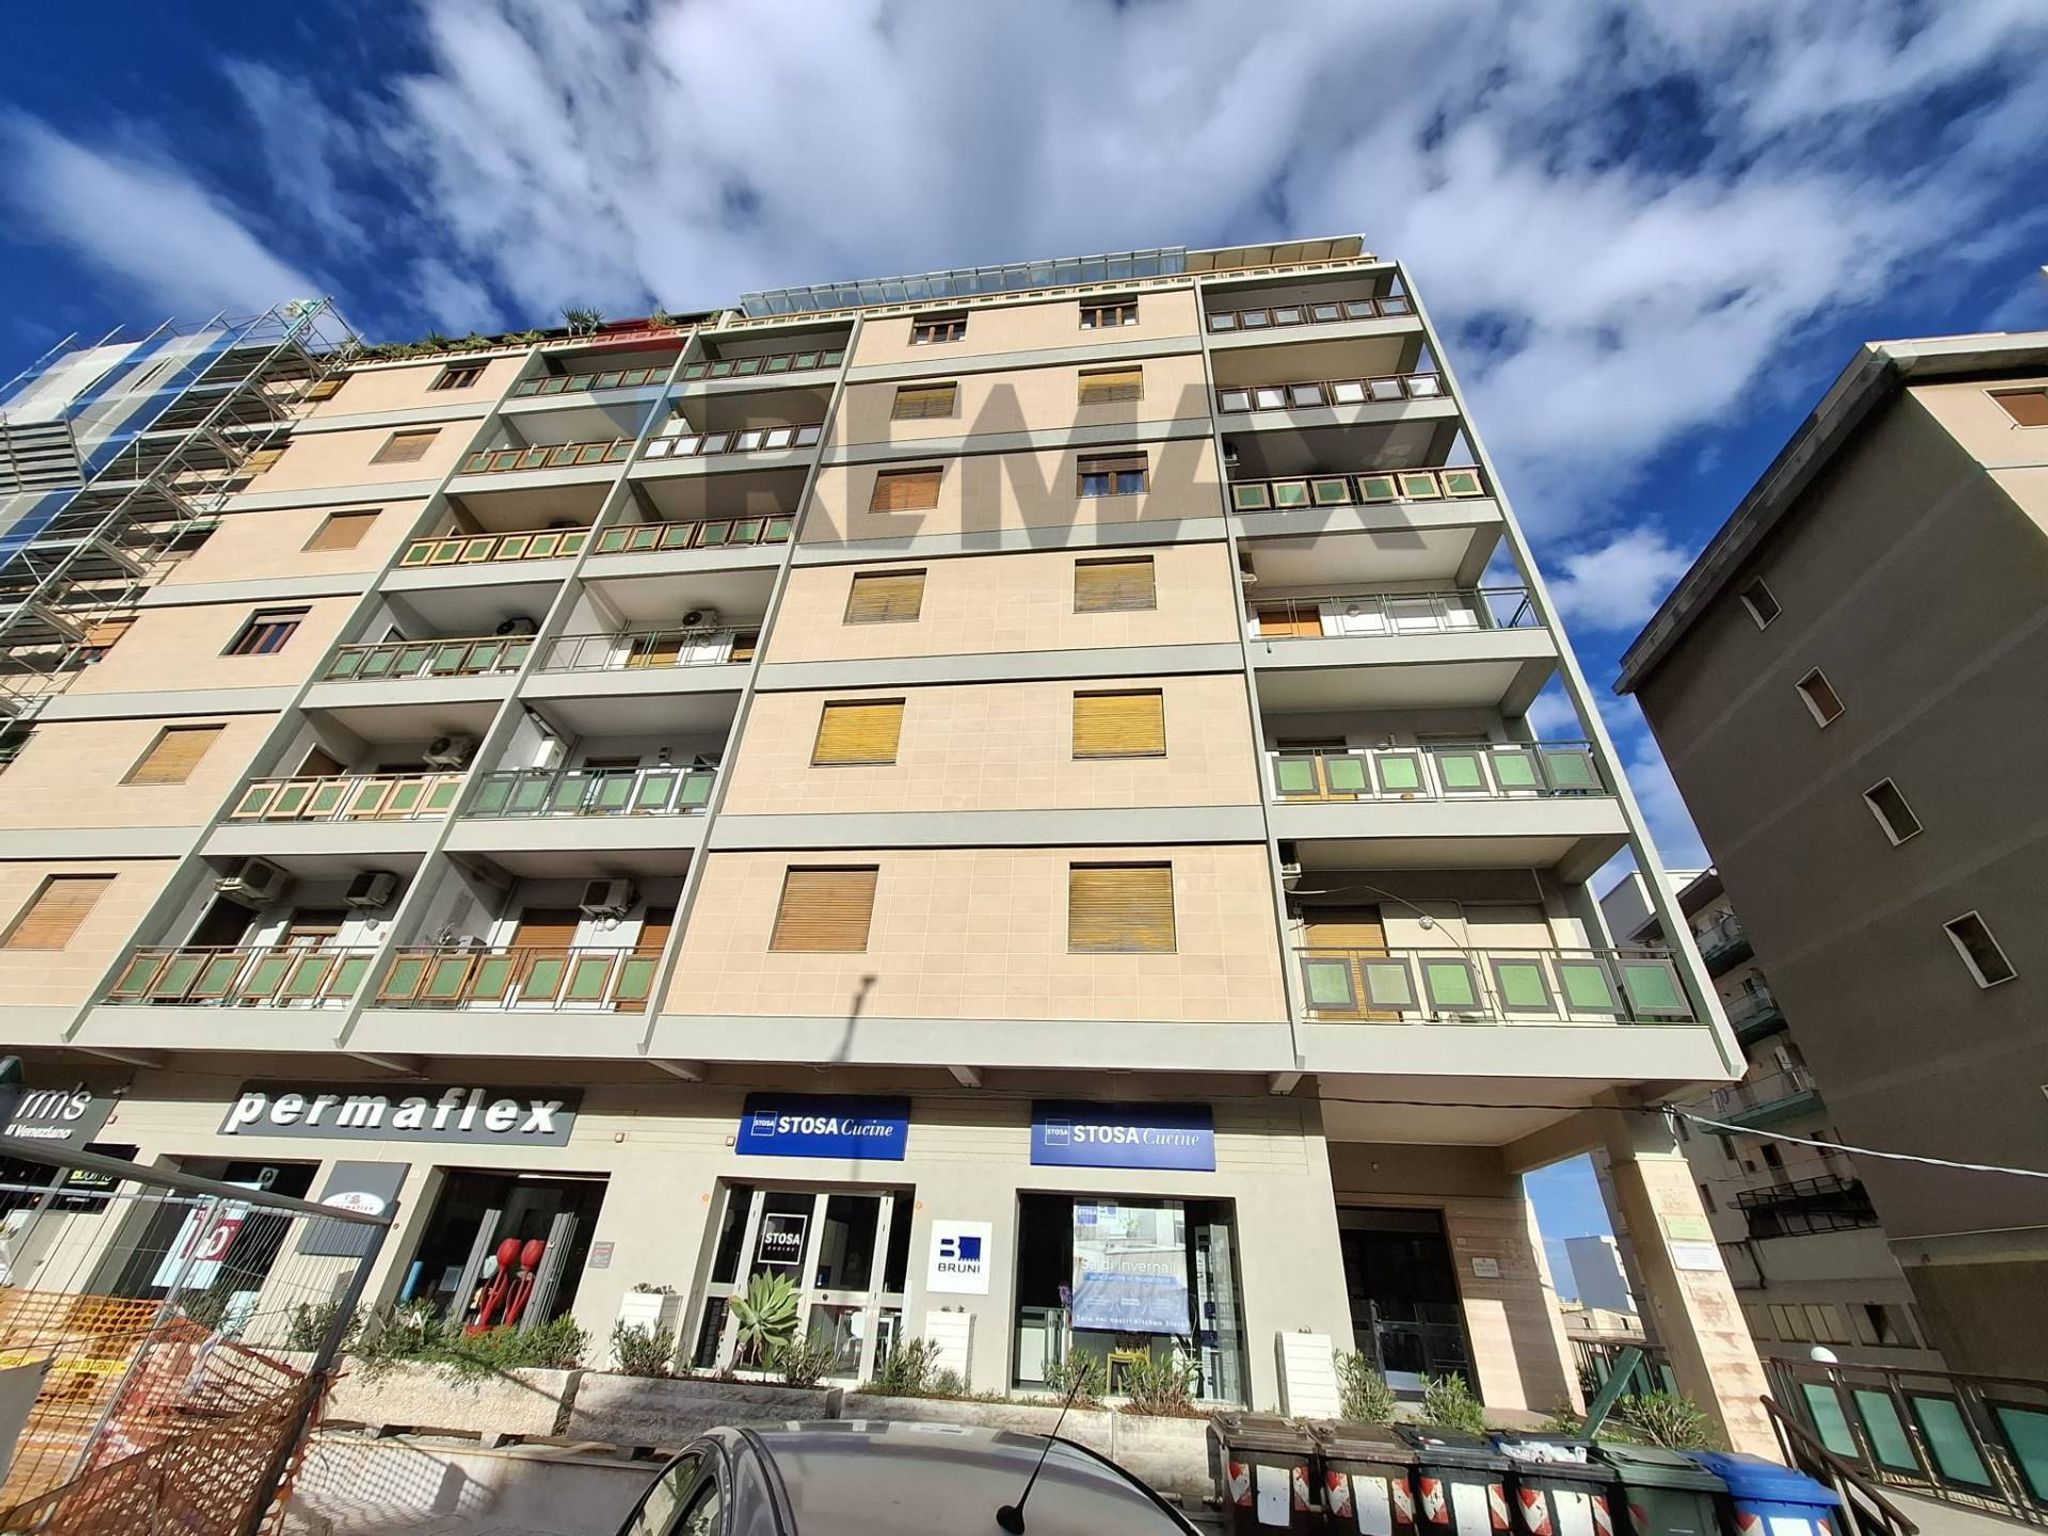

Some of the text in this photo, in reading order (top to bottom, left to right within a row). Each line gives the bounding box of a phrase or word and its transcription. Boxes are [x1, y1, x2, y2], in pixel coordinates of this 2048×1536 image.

[224, 1087, 564, 1134] permaflex
[13, 1124, 74, 1140] Veneziano
[777, 1116, 894, 1137] STOSA Cucine
[1073, 1124, 1199, 1146] STOSA Cucine
[764, 1232, 800, 1245] STOSA
[937, 1262, 981, 1274] BRUNI
